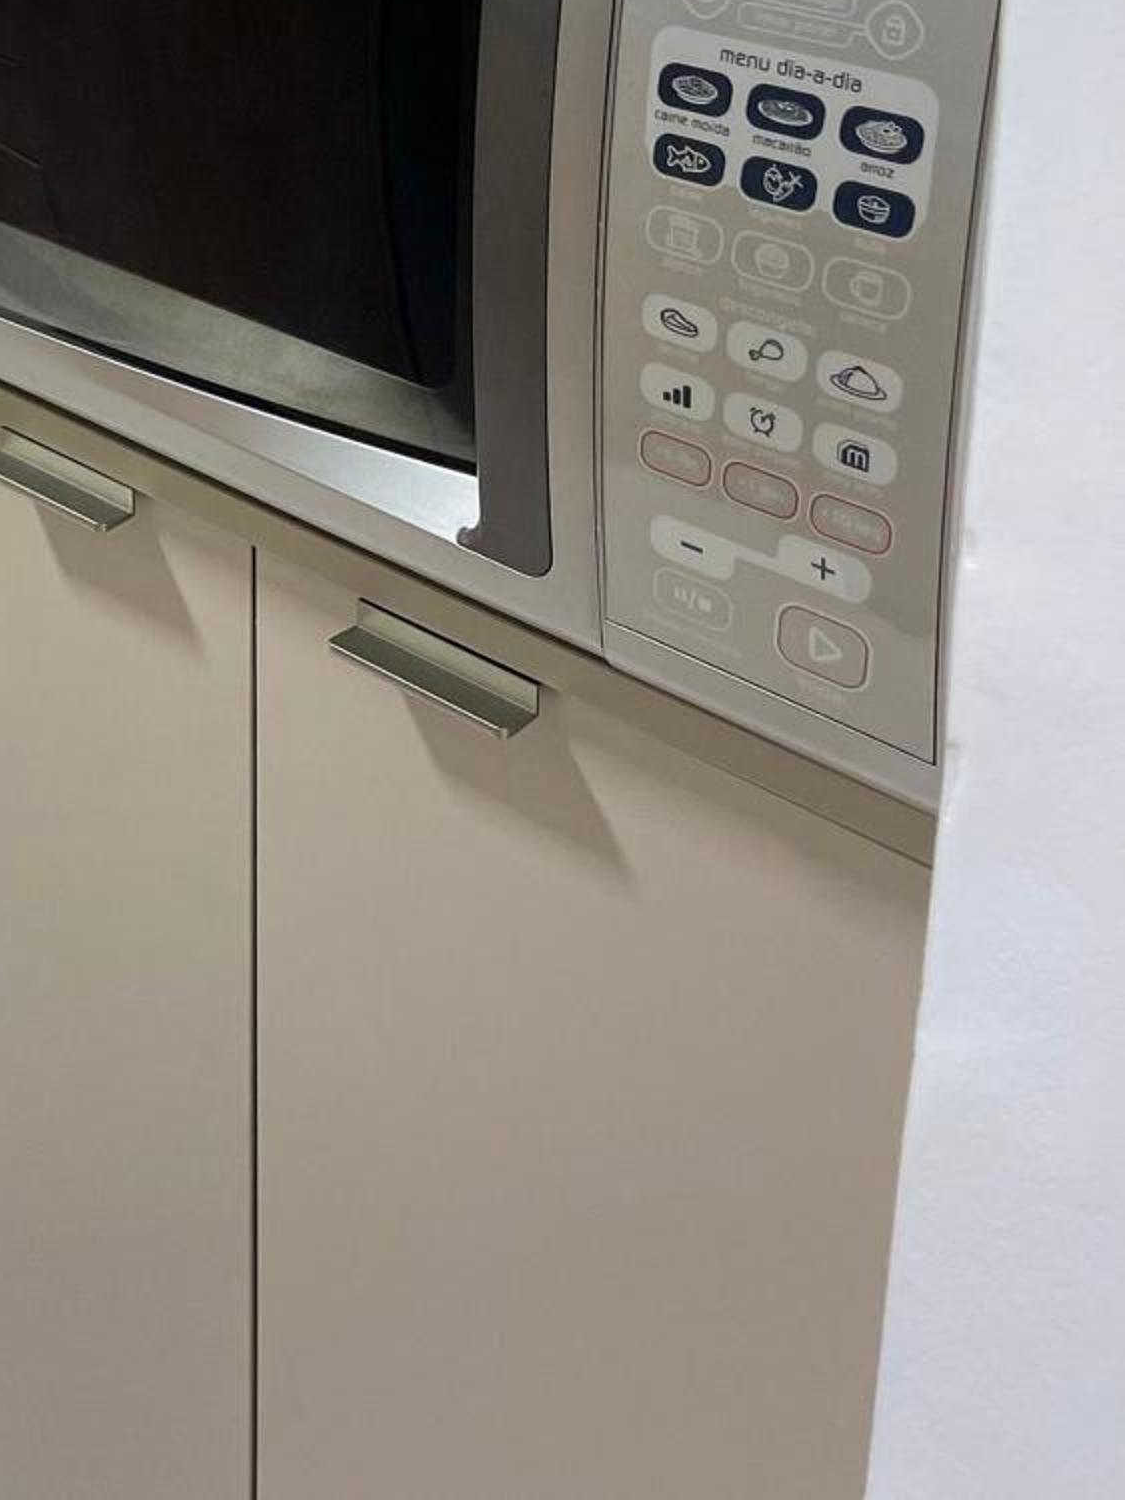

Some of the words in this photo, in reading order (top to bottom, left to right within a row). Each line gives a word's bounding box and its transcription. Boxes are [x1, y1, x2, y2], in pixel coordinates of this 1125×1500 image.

[720, 48, 770, 73] menu
[777, 59, 863, 94] dia-a-dia
[860, 160, 895, 179] arroz
